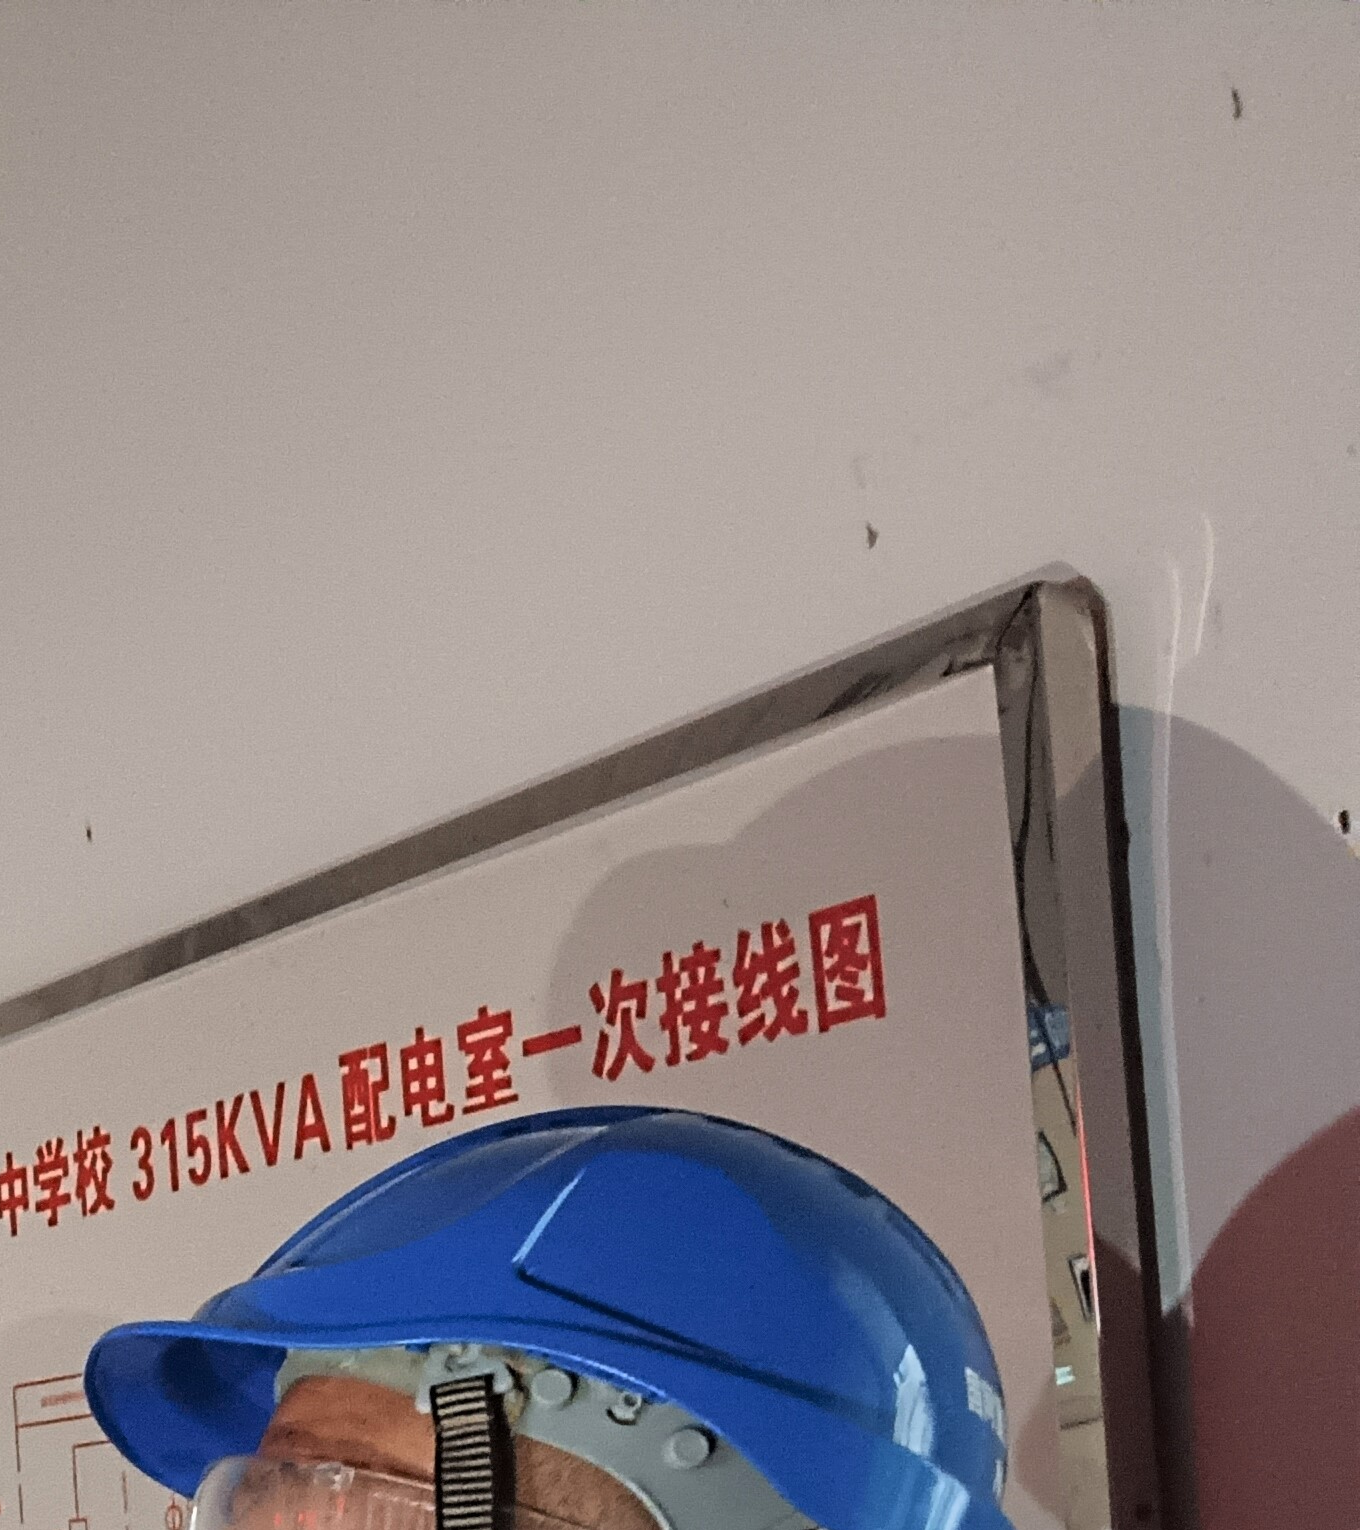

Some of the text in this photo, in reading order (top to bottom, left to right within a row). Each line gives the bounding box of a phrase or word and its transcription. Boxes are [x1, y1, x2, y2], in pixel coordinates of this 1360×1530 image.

[131, 1073, 333, 1202] 315KVA
[339, 894, 887, 1148] 配电室一次接线图
